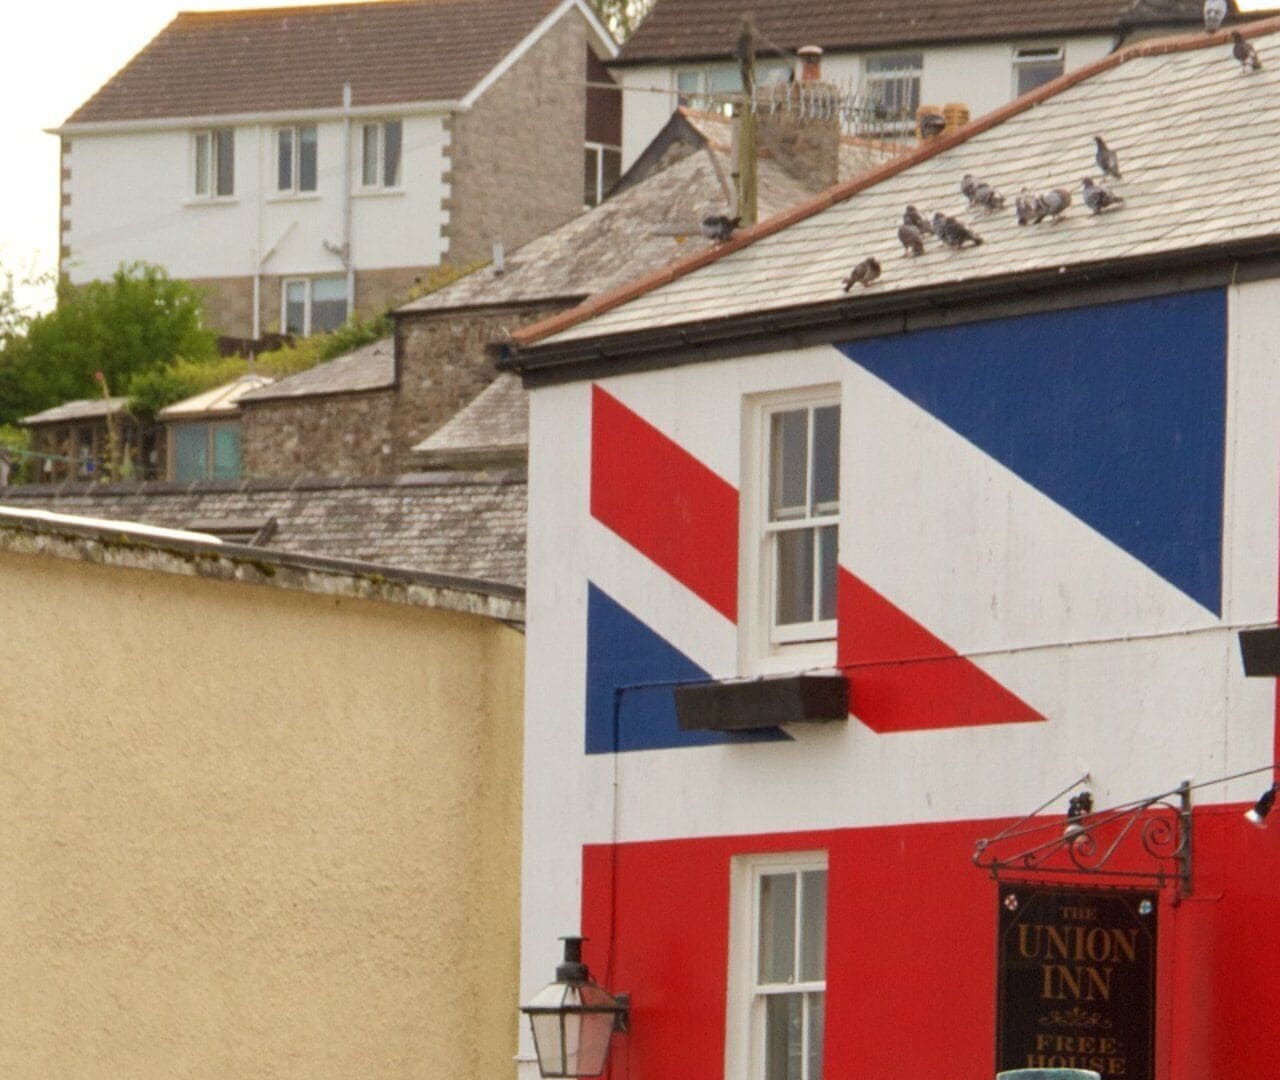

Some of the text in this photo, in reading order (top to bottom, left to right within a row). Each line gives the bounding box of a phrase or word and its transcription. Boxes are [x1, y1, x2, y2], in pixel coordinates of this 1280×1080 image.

[1063, 907, 1097, 920] THE
[1020, 925, 1139, 962] UNION
[1040, 964, 1114, 1001] INN
[1035, 1033, 1117, 1054] FREE
